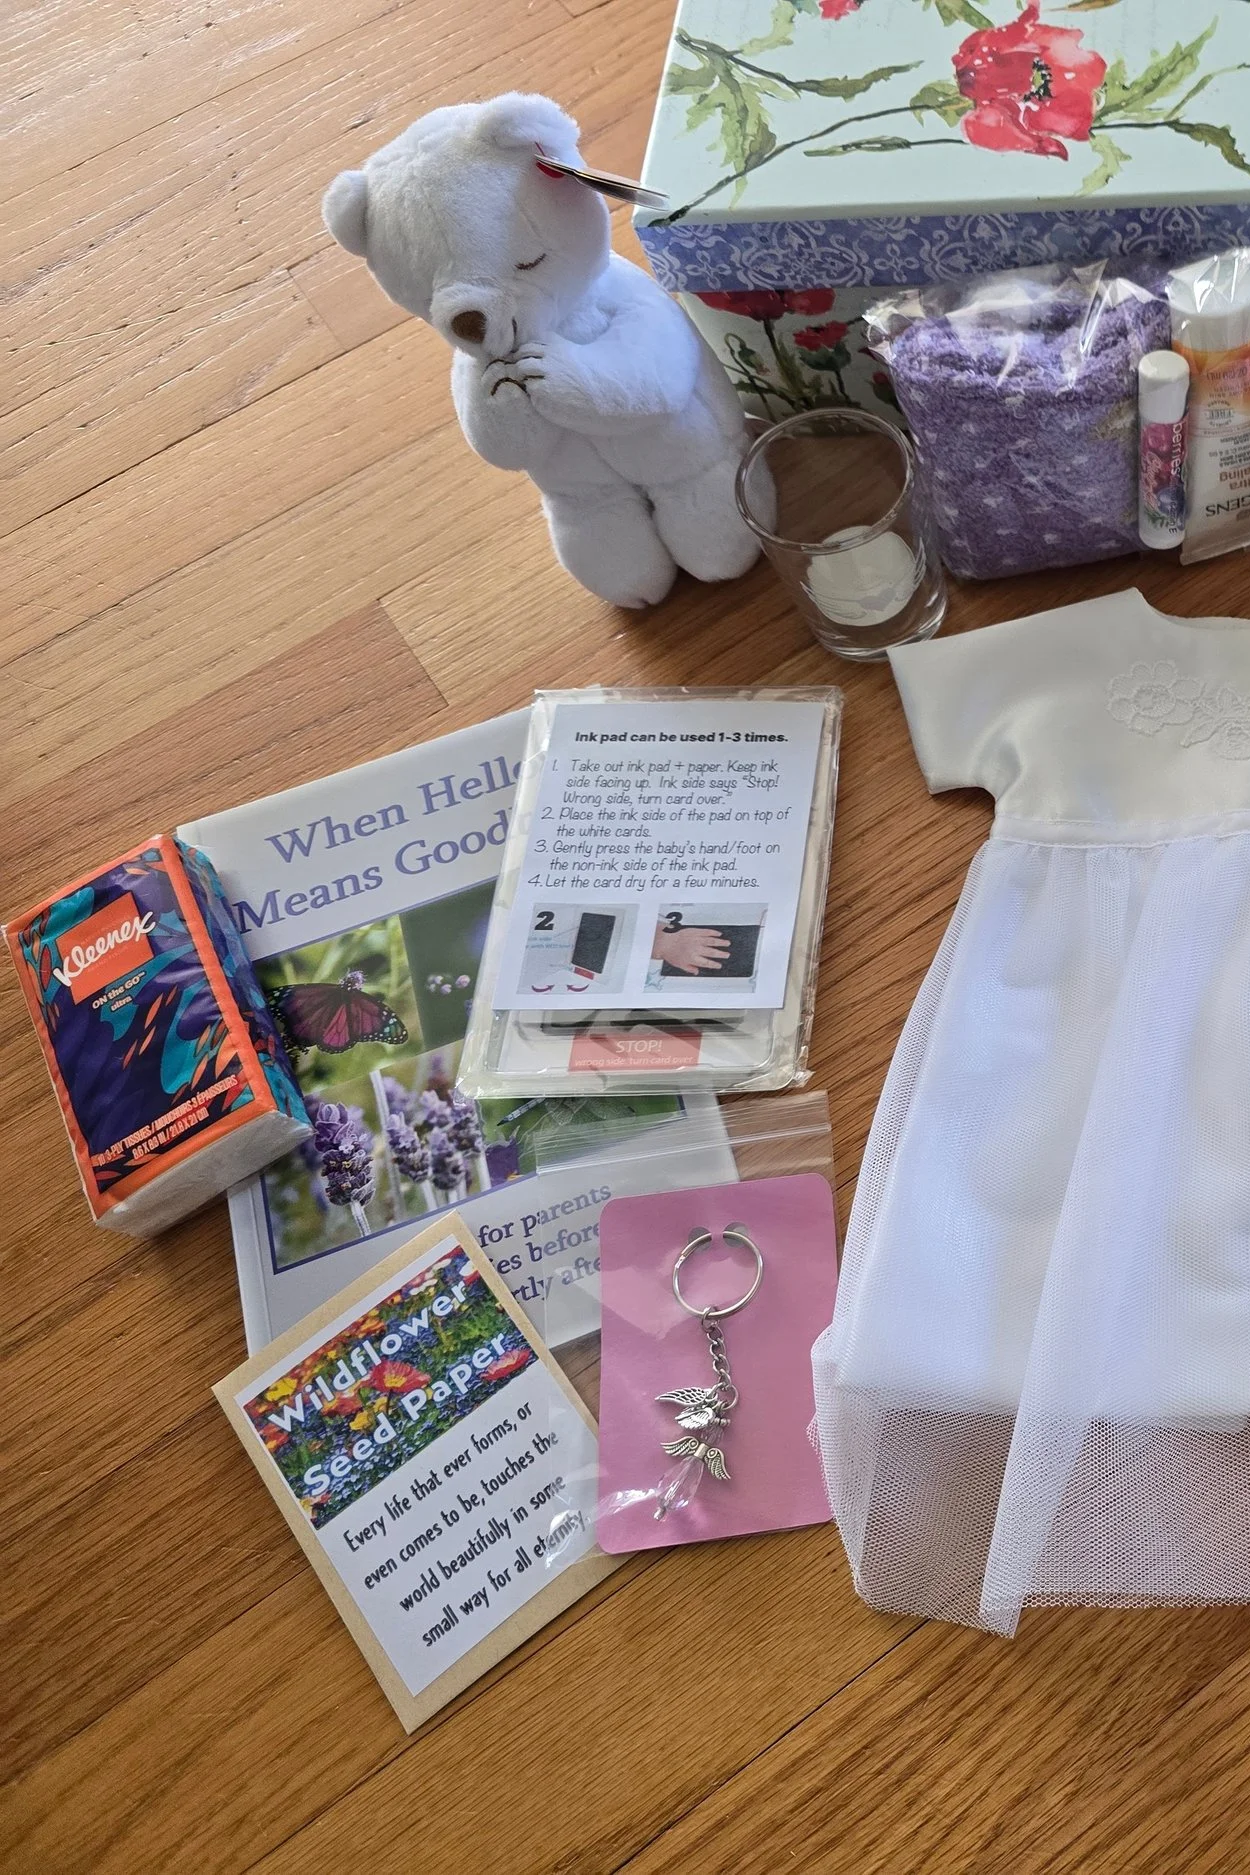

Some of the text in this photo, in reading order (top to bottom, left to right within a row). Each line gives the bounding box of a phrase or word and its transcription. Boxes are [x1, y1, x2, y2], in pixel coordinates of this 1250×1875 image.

[1171, 423, 1182, 475] berries
[575, 732, 788, 744] Ink pad can be used 1-3 times.
[572, 760, 600, 772] Take
[604, 760, 623, 771] out
[627, 760, 644, 772] ink
[649, 760, 670, 776] pad
[675, 762, 685, 771] +
[687, 761, 723, 775] paper.
[727, 760, 756, 775] Keep
[761, 759, 778, 772] ink
[566, 777, 590, 788] side
[595, 776, 631, 791] facing
[634, 779, 651, 791] up.
[660, 777, 677, 788] Ink
[682, 777, 705, 788] side
[709, 779, 737, 792] says
[563, 791, 600, 806] Wrong
[606, 792, 633, 806] side,
[638, 793, 661, 804] turn
[666, 792, 692, 804] card
[559, 808, 593, 821] Place
[598, 807, 616, 821] the
[620, 809, 637, 821] ink
[642, 809, 665, 821] side
[670, 807, 685, 821] of
[688, 807, 704, 821] the
[708, 809, 731, 825] pad
[735, 811, 749, 821] on
[754, 809, 773, 824] top
[777, 806, 792, 820] of
[265, 802, 409, 863] When
[556, 824, 652, 837] the white cards.
[534, 840, 549, 852] 3.
[553, 840, 592, 856] Gently
[596, 843, 630, 858] press
[634, 840, 653, 854] the
[700, 840, 761, 854] hand/foot
[766, 844, 780, 854] on
[232, 806, 513, 934] Means Good
[550, 858, 738, 874] the non-ink side of the ink pad.
[528, 874, 760, 891] 4. Let the card dry for a few minutes.
[534, 911, 555, 930] 2
[662, 912, 683, 933] 3
[53, 911, 156, 986] Kleenex
[92, 995, 108, 1009] ON
[108, 987, 124, 1000] the
[111, 996, 132, 1011] ultra
[616, 1040, 662, 1053] STOP!
[575, 1059, 604, 1067] wrong
[630, 1057, 648, 1065] turn
[651, 1056, 670, 1064] card
[105, 1143, 125, 1159] 3-PLY
[125, 1125, 151, 1147] TISSUES
[478, 1185, 612, 1248] for parents
[268, 1280, 467, 1433] Wildflower
[303, 1333, 508, 1496] Seed Paper
[344, 1402, 532, 1552] Every life that ever forms, or
[364, 1430, 558, 1590] even comes to be, touches the
[400, 1475, 566, 1611] world beautifully in some
[423, 1605, 459, 1647] small
[460, 1587, 490, 1614] way
[487, 1568, 512, 1592] for
[514, 1546, 532, 1573] all
